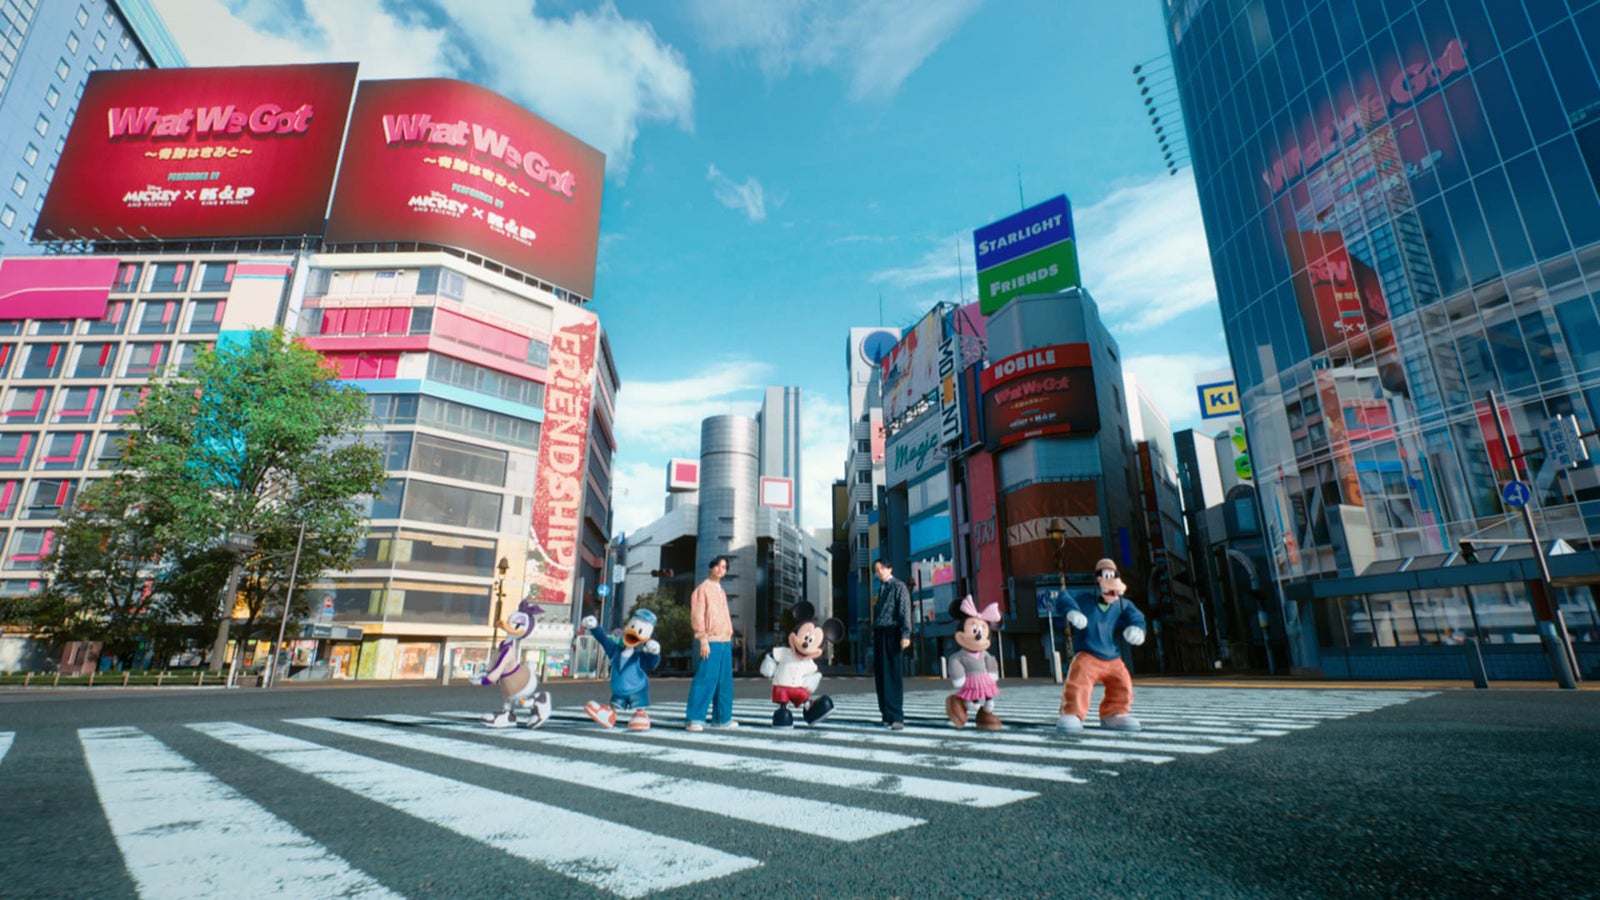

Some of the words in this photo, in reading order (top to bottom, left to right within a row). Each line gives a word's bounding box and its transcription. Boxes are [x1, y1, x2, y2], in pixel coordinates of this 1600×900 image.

[108, 106, 195, 138] What
[196, 105, 248, 135] We
[249, 103, 313, 133] Got
[382, 114, 470, 147] What
[471, 123, 523, 169] We
[523, 151, 576, 197] Got
[122, 189, 181, 202] MICKEY
[408, 195, 469, 214] MICKEY
[978, 214, 1062, 256] STARLIGHT
[989, 264, 1058, 297] FRIENDS
[994, 349, 1056, 379] MOBILE
[547, 331, 581, 567] FRIENDSHIP
[894, 431, 939, 471] Magic
